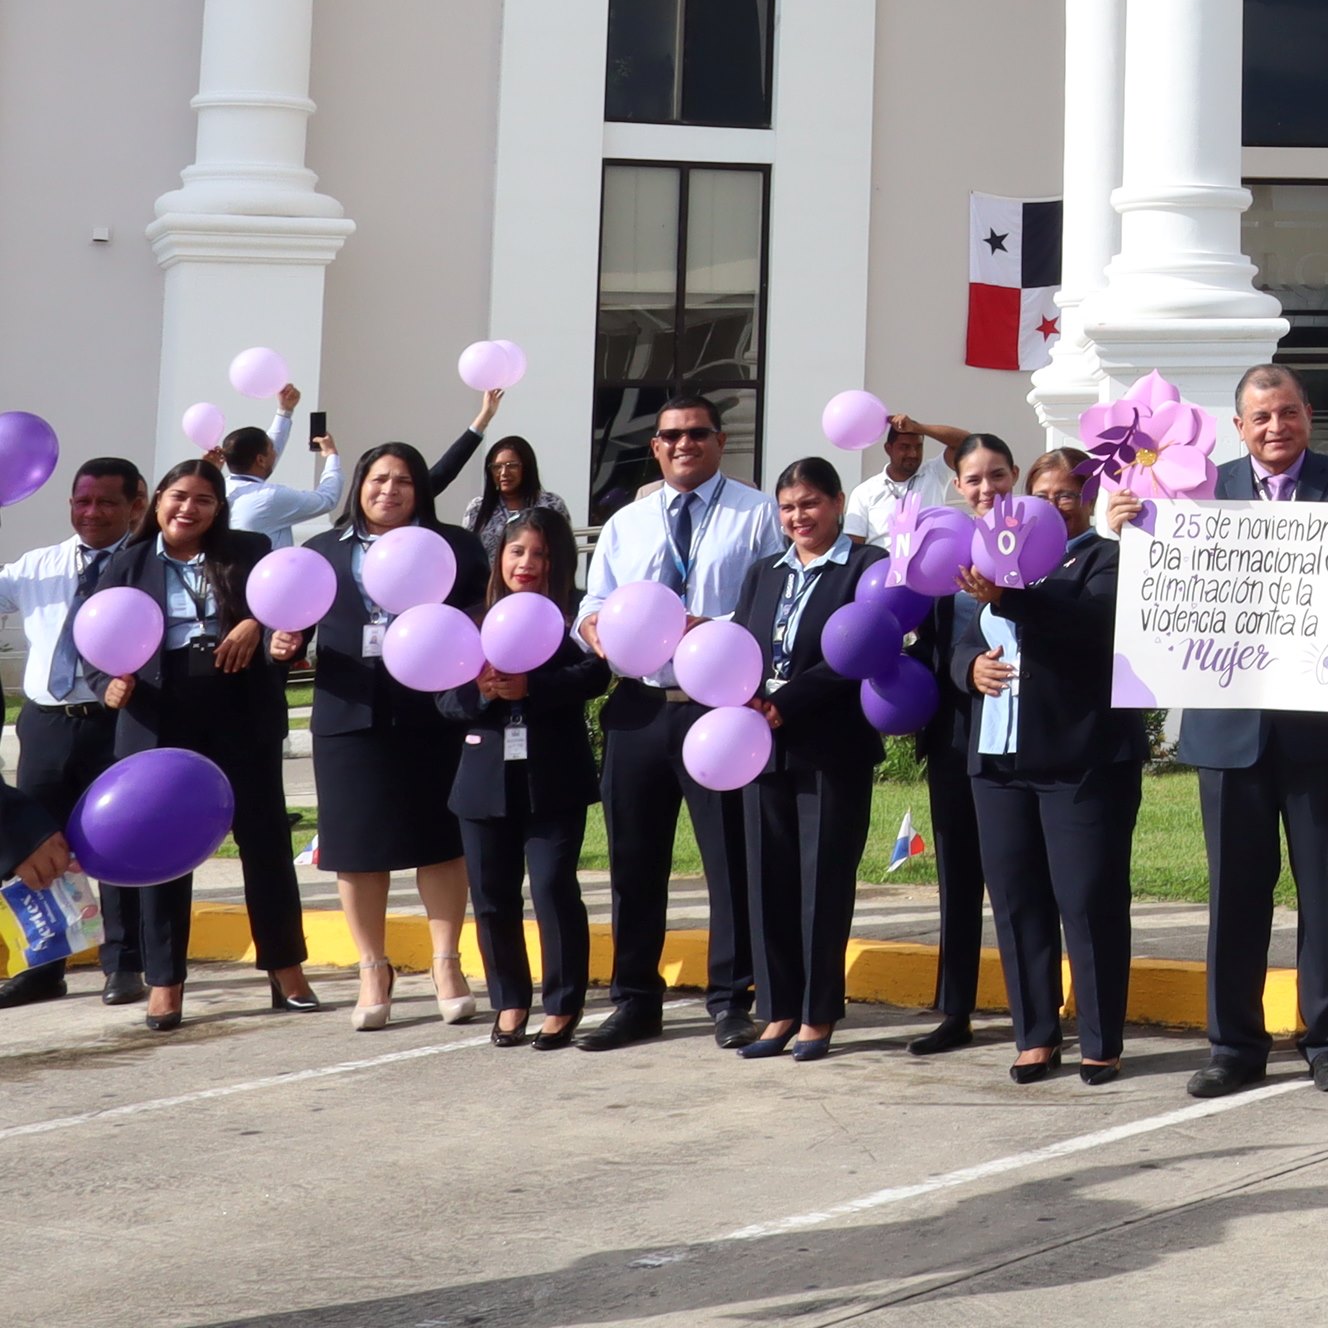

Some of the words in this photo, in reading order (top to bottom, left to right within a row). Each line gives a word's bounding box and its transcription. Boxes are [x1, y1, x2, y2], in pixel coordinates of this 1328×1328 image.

[1172, 513, 1201, 538] 25
[1205, 508, 1231, 539] de
[895, 532, 911, 558] N
[997, 530, 1016, 555] O
[1191, 542, 1323, 575] internacional
[1141, 572, 1264, 604] eliminación
[1268, 576, 1292, 606] de
[1296, 577, 1313, 606] la
[1141, 605, 1226, 634] violencia
[1235, 605, 1297, 635] contra
[1301, 608, 1319, 637] la
